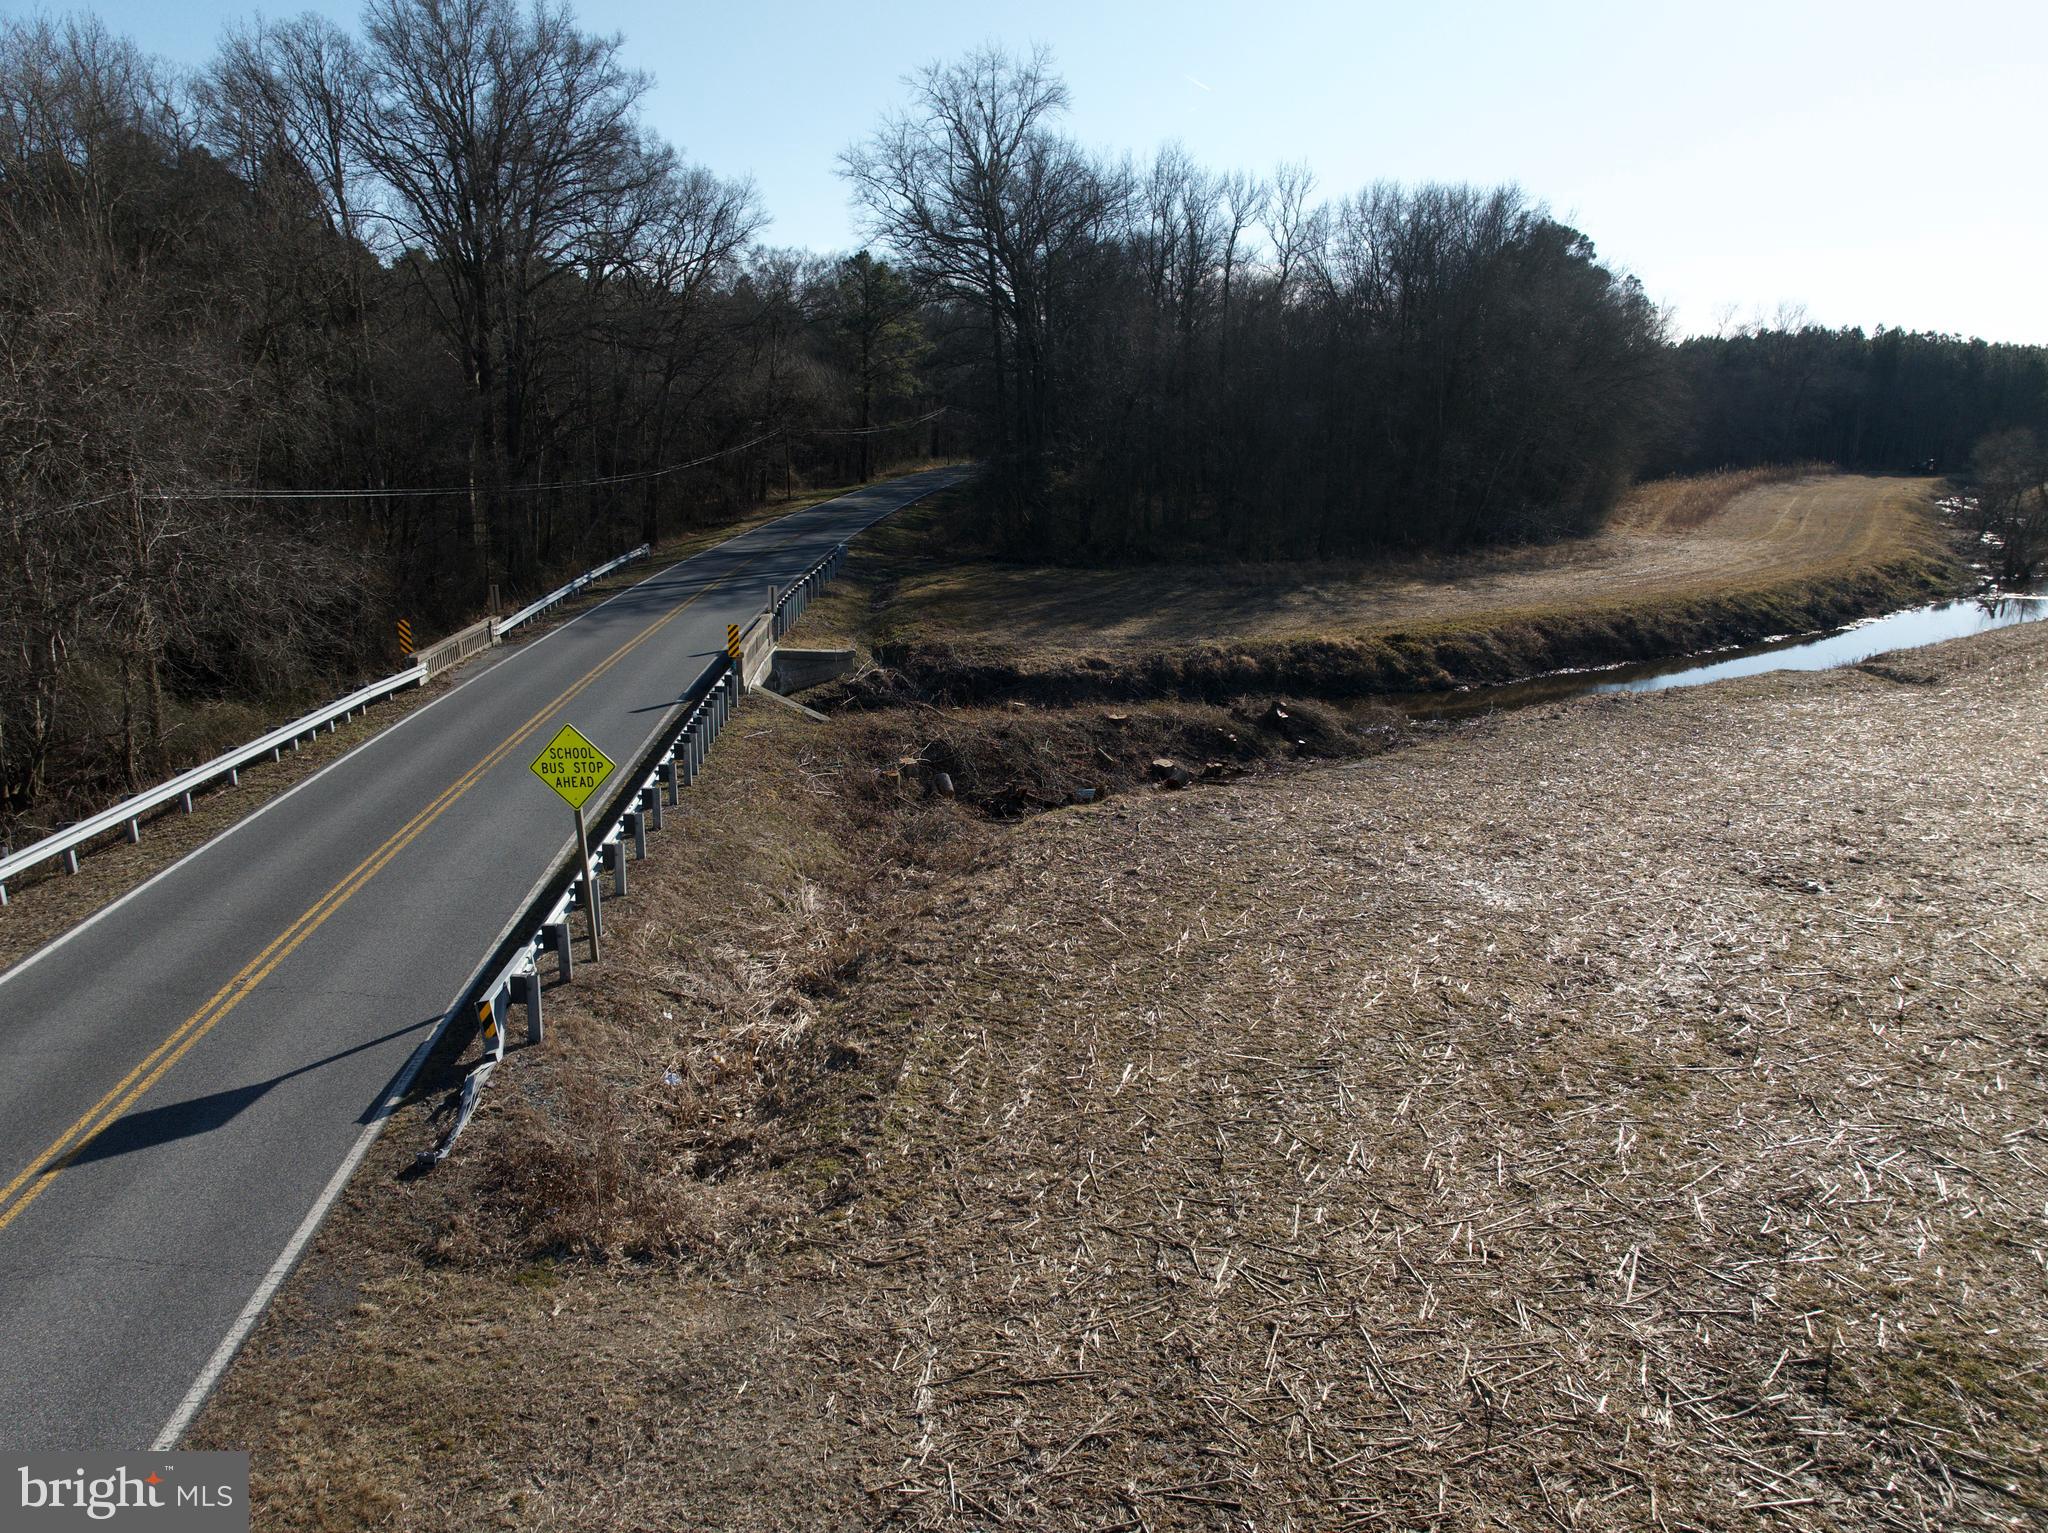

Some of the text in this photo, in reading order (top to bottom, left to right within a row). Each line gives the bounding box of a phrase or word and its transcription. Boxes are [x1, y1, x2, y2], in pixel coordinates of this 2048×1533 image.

[549, 747, 595, 759] SCHOOL
[541, 761, 604, 774] BUS STOP
[555, 776, 595, 788] AHEAD
